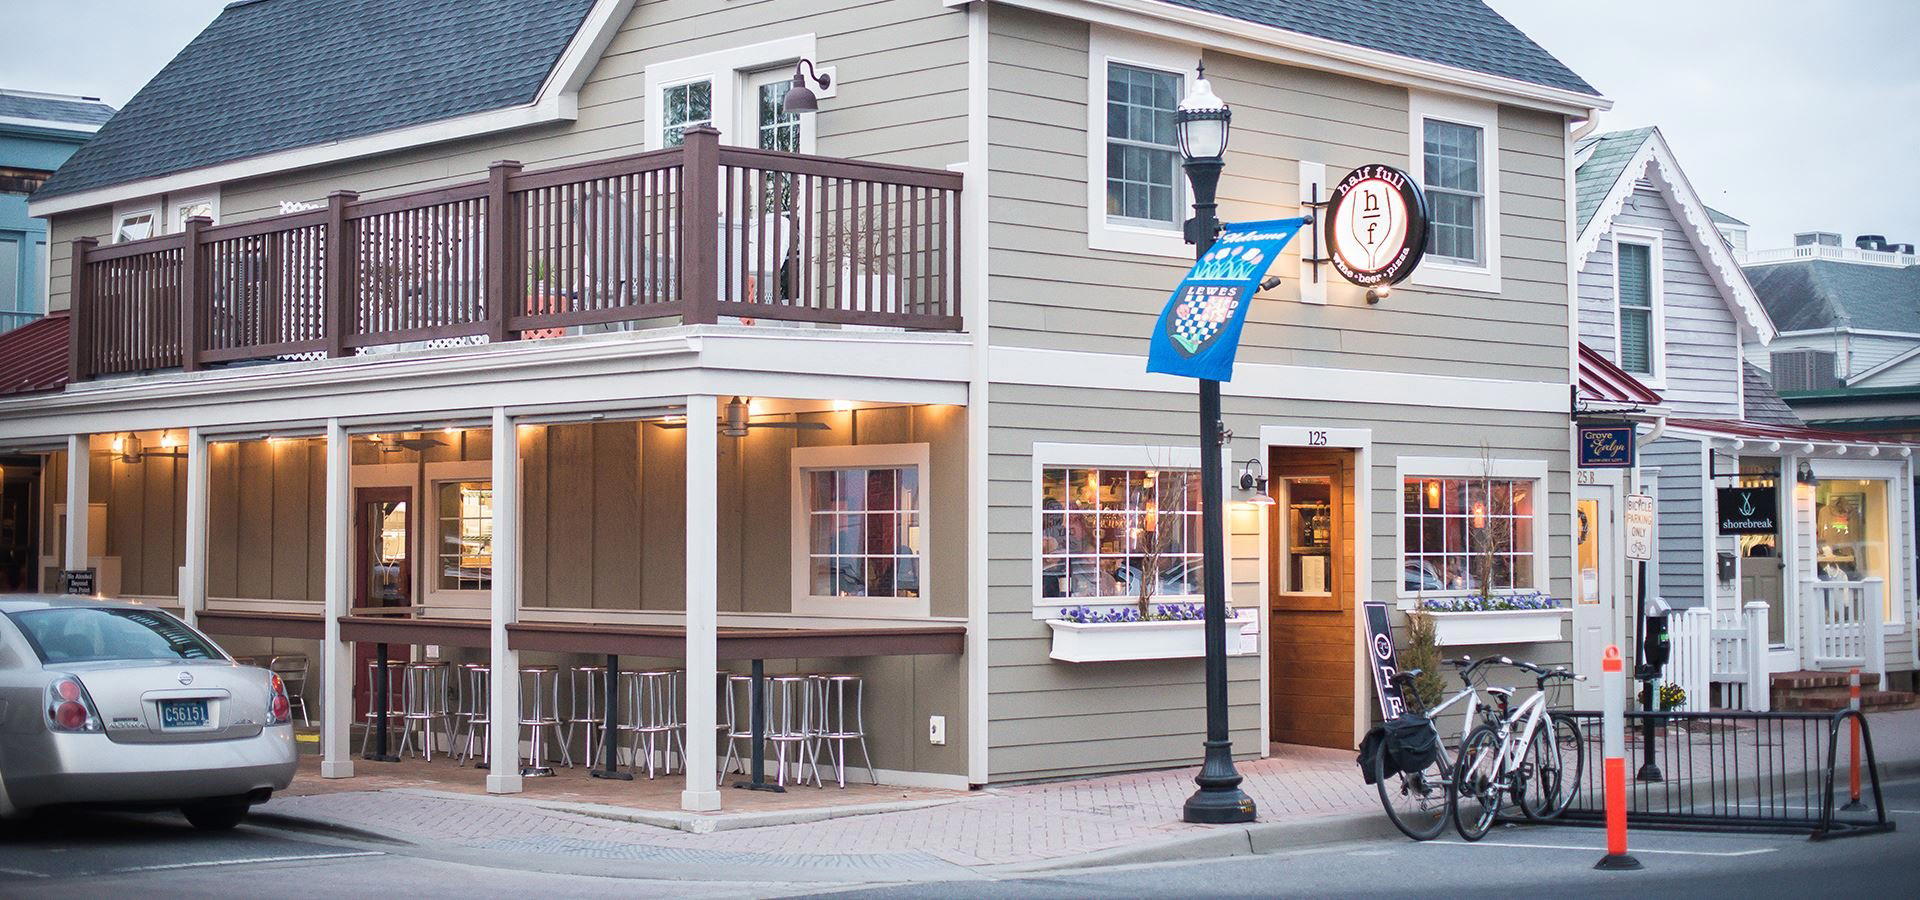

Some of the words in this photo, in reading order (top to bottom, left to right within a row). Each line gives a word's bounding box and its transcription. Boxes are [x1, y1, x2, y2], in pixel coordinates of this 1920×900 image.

[1337, 167, 1371, 196] half
[1375, 167, 1405, 190] full
[1364, 190, 1379, 211] h
[1222, 231, 1287, 244] Welcome
[1368, 222, 1377, 244] f
[1333, 251, 1354, 278] wine
[1358, 272, 1382, 283] beer
[1386, 247, 1410, 278] pizza
[1187, 286, 1237, 296] LEWES
[1308, 431, 1327, 446] 125
[1585, 431, 1613, 440] Grove
[1628, 500, 1652, 512] BICYCLE
[1627, 512, 1653, 525] PARKING
[1723, 518, 1773, 529] shorebreak
[1632, 526, 1646, 537] ONLY
[1374, 633, 1404, 720] OPE
[165, 706, 206, 721] C56151
